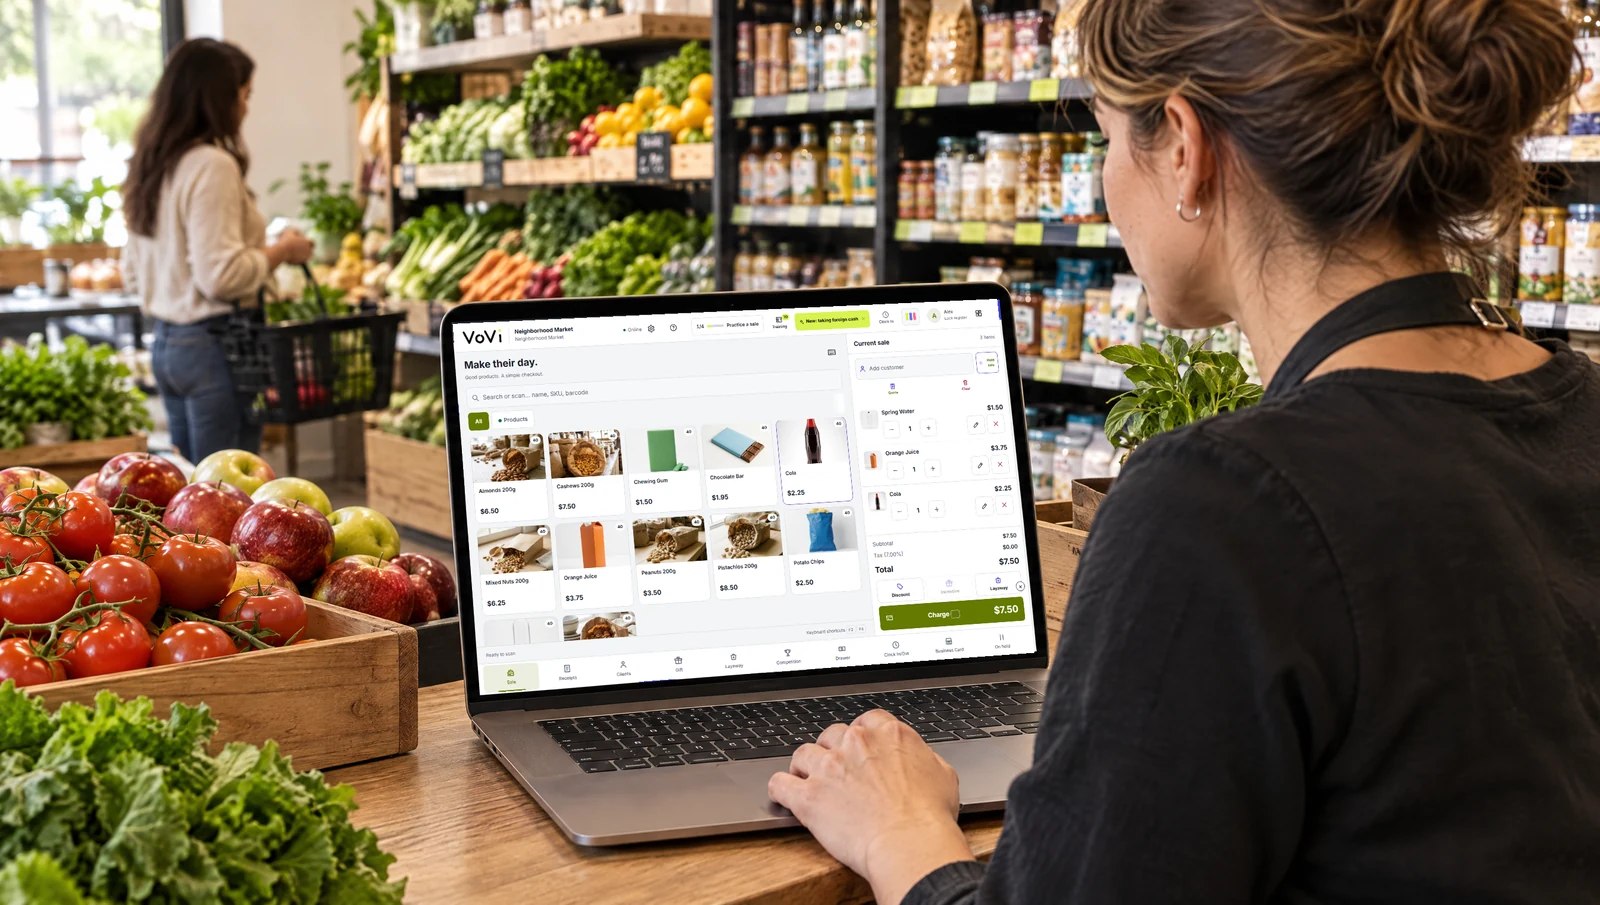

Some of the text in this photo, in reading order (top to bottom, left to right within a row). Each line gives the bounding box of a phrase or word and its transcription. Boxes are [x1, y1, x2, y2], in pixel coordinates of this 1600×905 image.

[462, 329, 502, 344] VoVi
[464, 358, 538, 370] Make their day.
[998, 557, 1019, 565] $7.50
[994, 604, 1019, 615] $7.50
